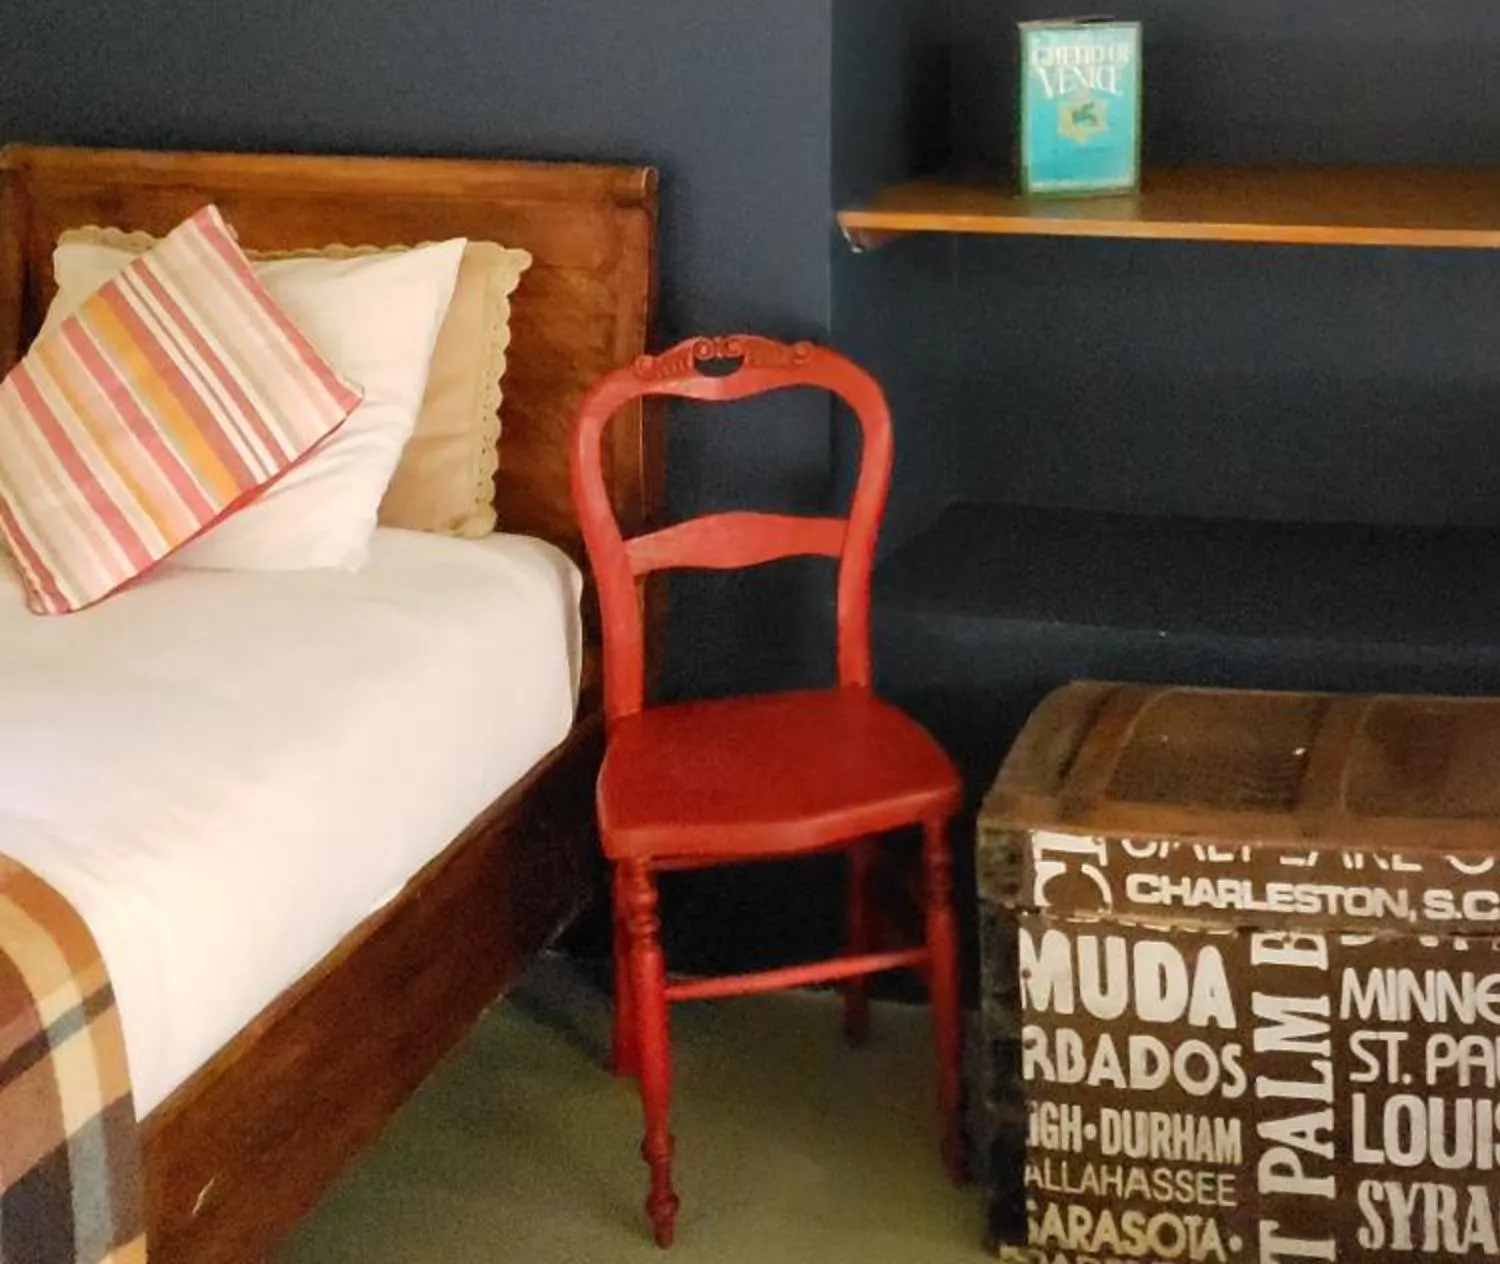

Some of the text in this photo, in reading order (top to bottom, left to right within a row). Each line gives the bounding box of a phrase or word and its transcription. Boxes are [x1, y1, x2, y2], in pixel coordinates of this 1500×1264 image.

[1125, 872, 1418, 923] CHARLESTON,
[1018, 927, 1237, 1030] MUDA
[1021, 1024, 1248, 1099] RBADOS
[1251, 991, 1336, 1199] PALM
[1350, 1030, 1413, 1085] ST.
